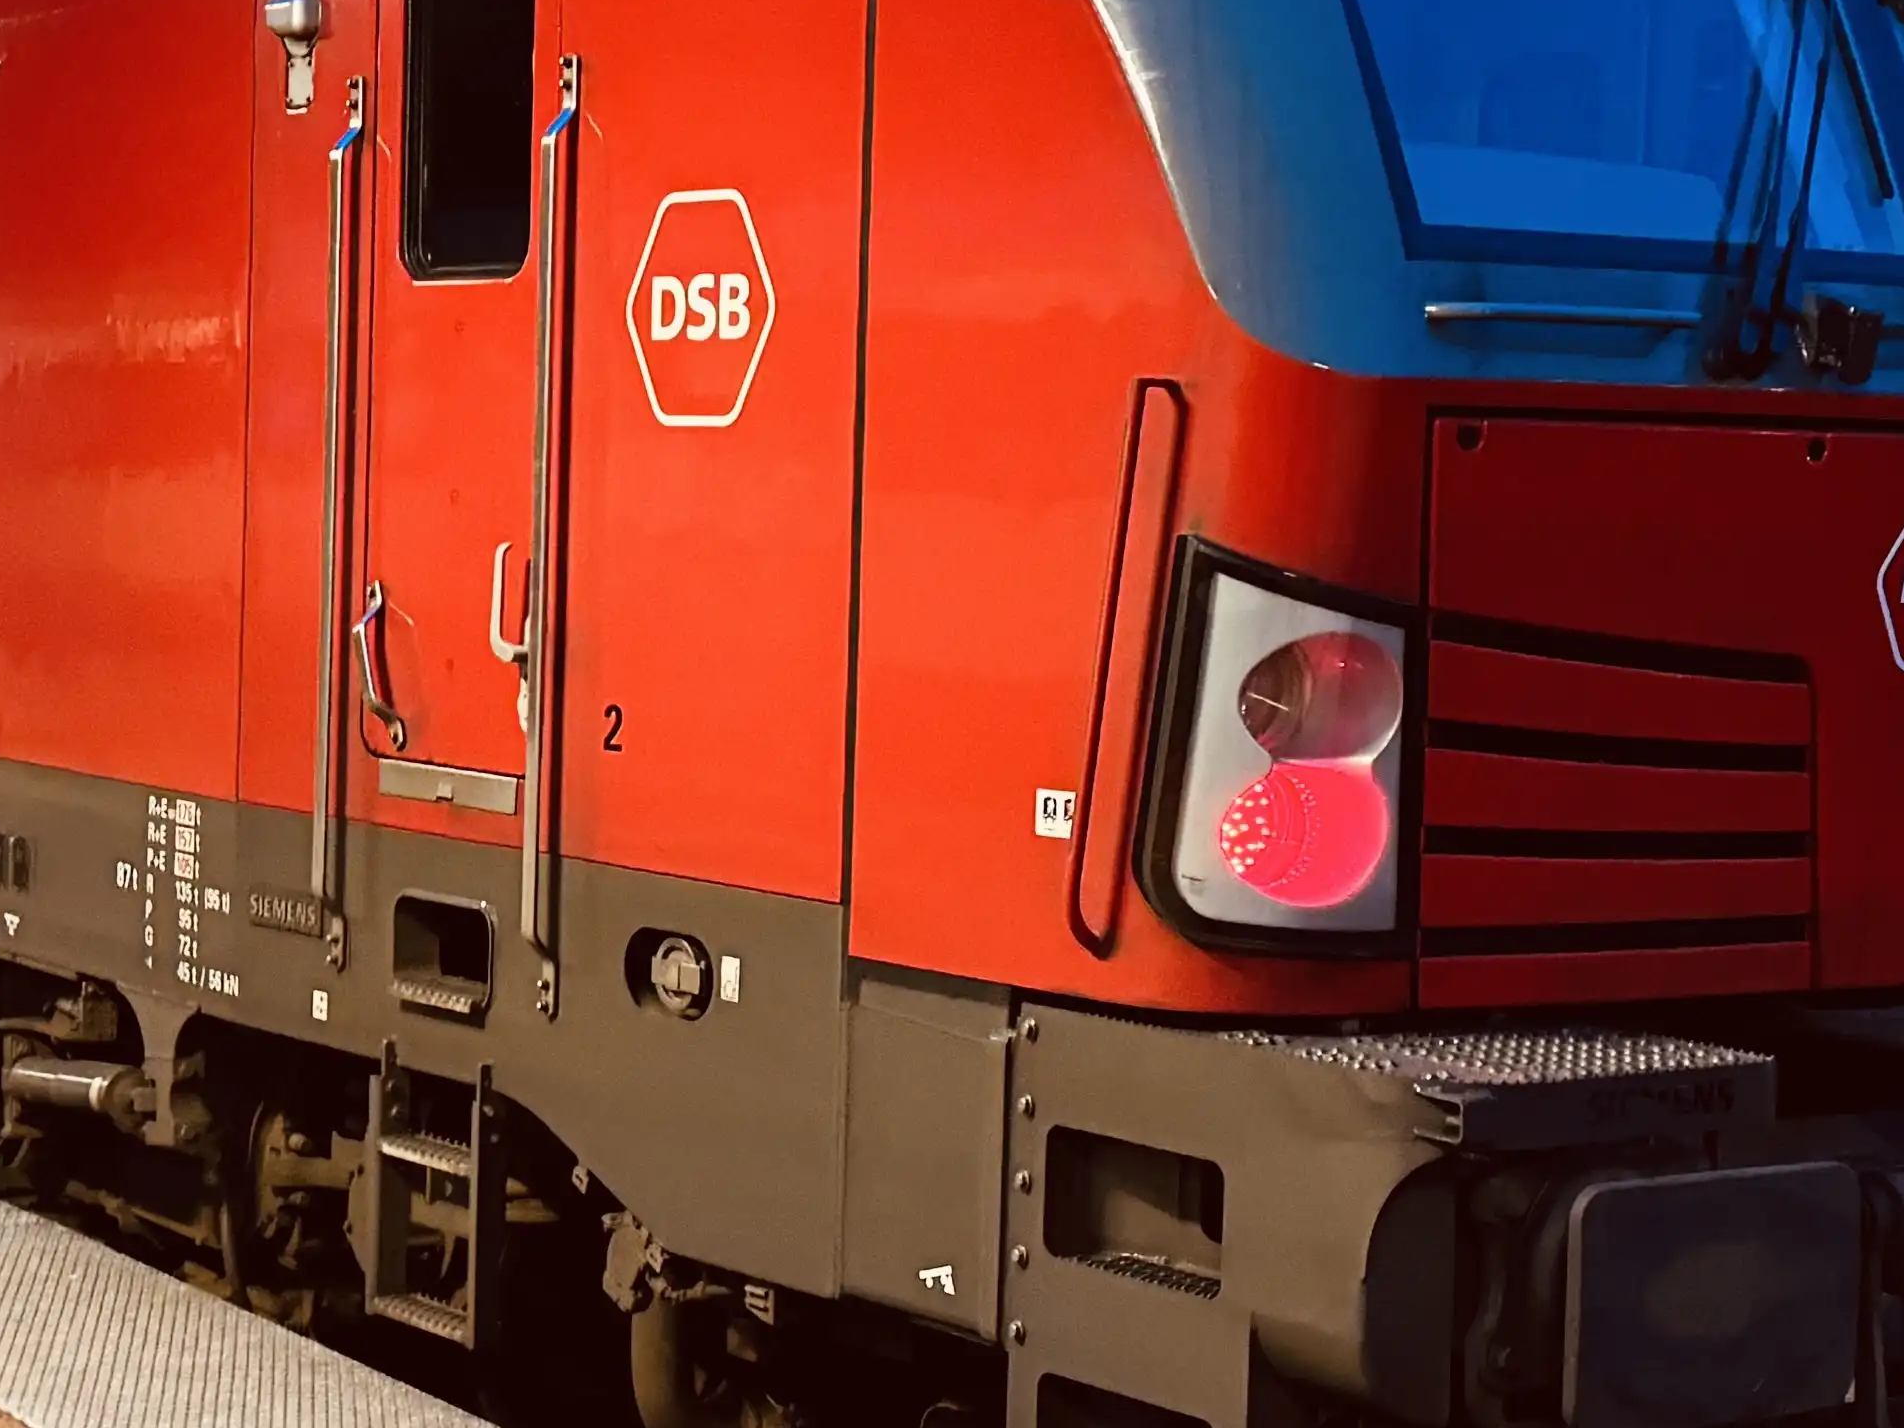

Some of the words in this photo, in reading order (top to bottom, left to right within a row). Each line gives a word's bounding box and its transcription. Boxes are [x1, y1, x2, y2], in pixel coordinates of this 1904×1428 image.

[650, 272, 751, 342] DSB
[603, 703, 623, 753] 2
[145, 899, 153, 920] P
[249, 893, 317, 927] SIEMENS
[144, 924, 154, 947] G
[178, 933, 192, 957] 72
